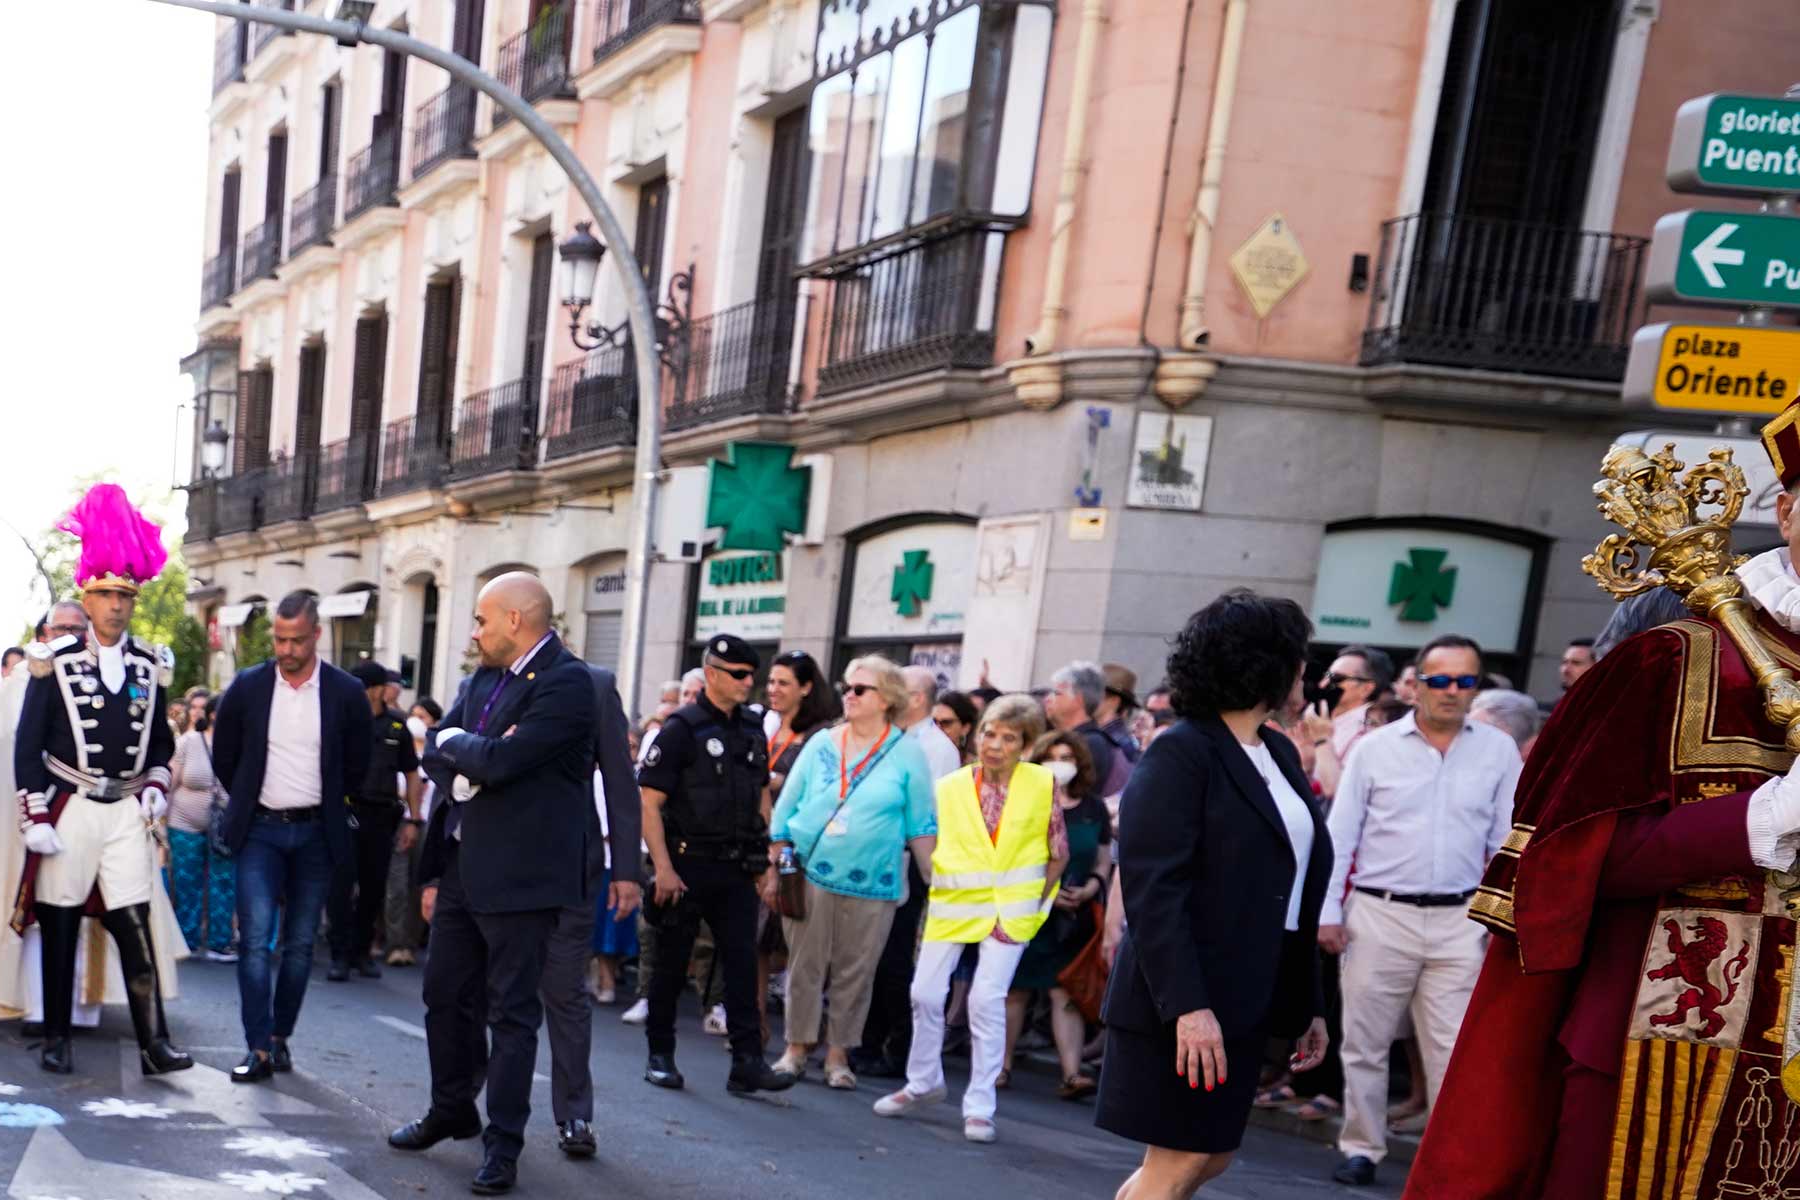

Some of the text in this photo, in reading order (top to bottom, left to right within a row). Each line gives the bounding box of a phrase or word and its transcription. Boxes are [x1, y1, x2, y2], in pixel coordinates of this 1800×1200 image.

[1703, 138, 1800, 175] Puent
[1674, 334, 1741, 358] plaza
[1666, 363, 1787, 398] Oriente
